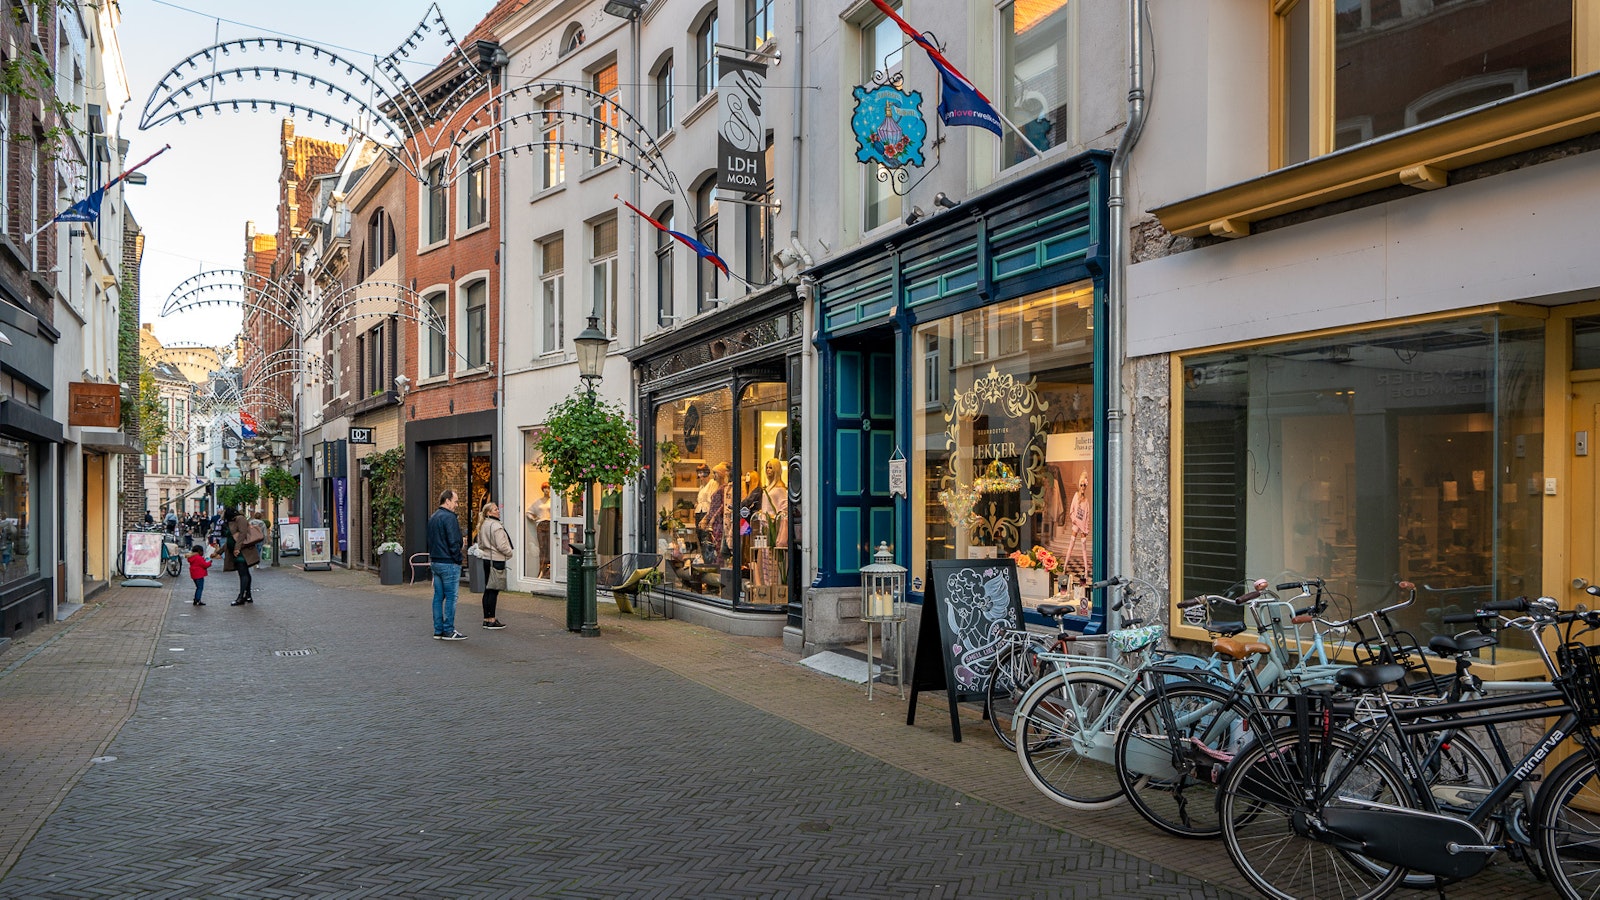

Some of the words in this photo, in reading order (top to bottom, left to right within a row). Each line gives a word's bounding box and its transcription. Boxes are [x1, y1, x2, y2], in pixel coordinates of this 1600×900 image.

[727, 156, 758, 174] LDH
[727, 174, 758, 187] MODA
[351, 428, 371, 440] DCT
[972, 441, 1017, 460] LEKKER
[1513, 729, 1565, 780] minerva
